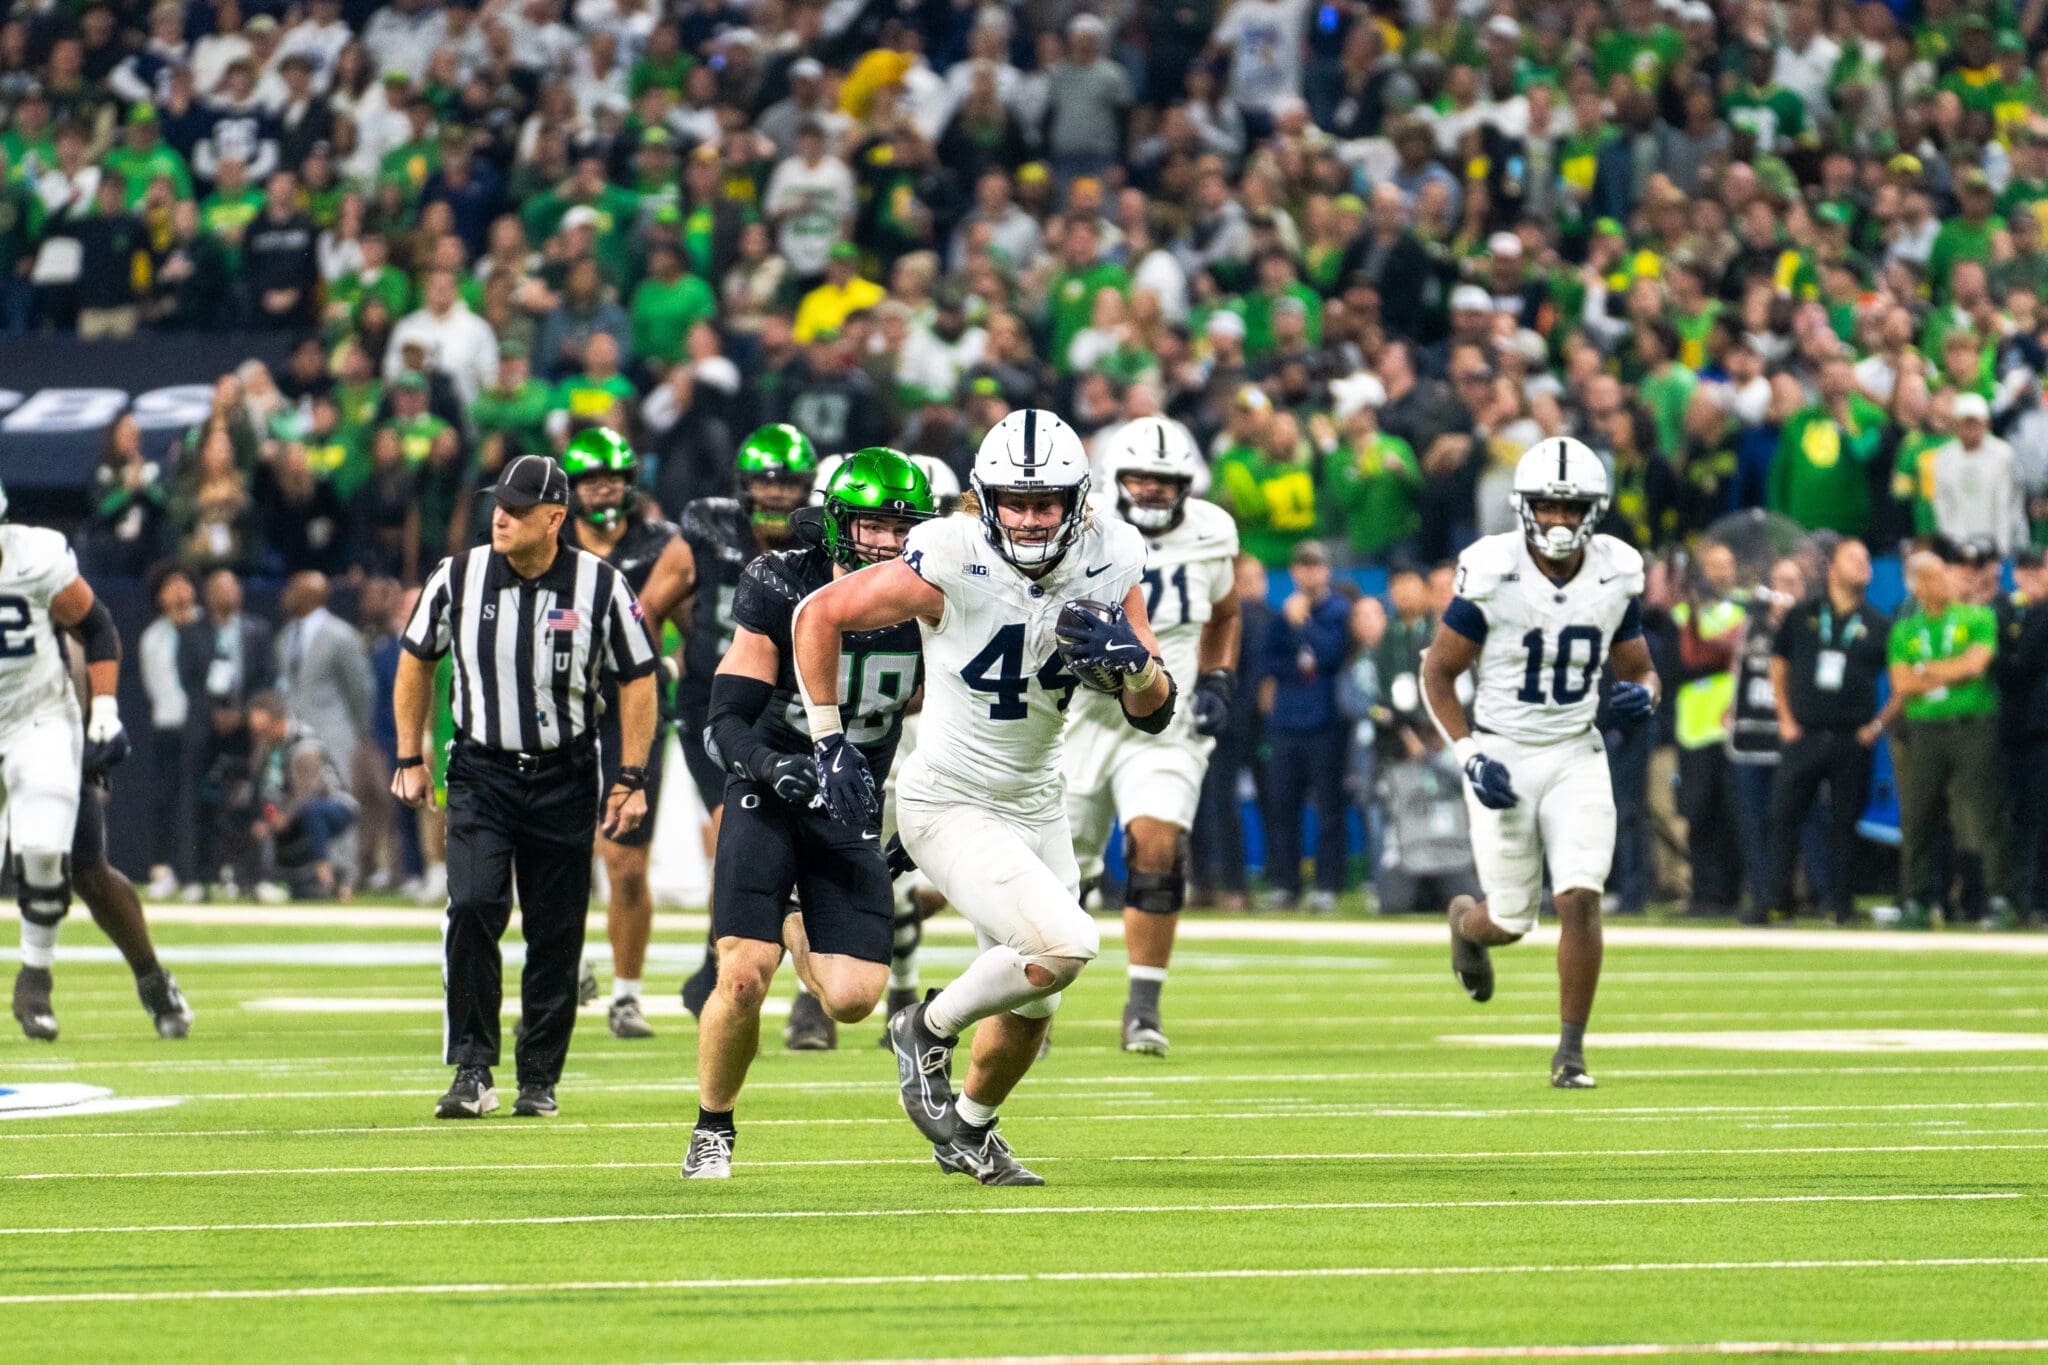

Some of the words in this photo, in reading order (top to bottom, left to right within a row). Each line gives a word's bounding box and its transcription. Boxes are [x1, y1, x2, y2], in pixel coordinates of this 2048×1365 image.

[1140, 563, 1190, 624] 71
[482, 604, 496, 620] S
[555, 652, 570, 672] U
[1517, 625, 1602, 705] 10
[741, 794, 761, 809] O
